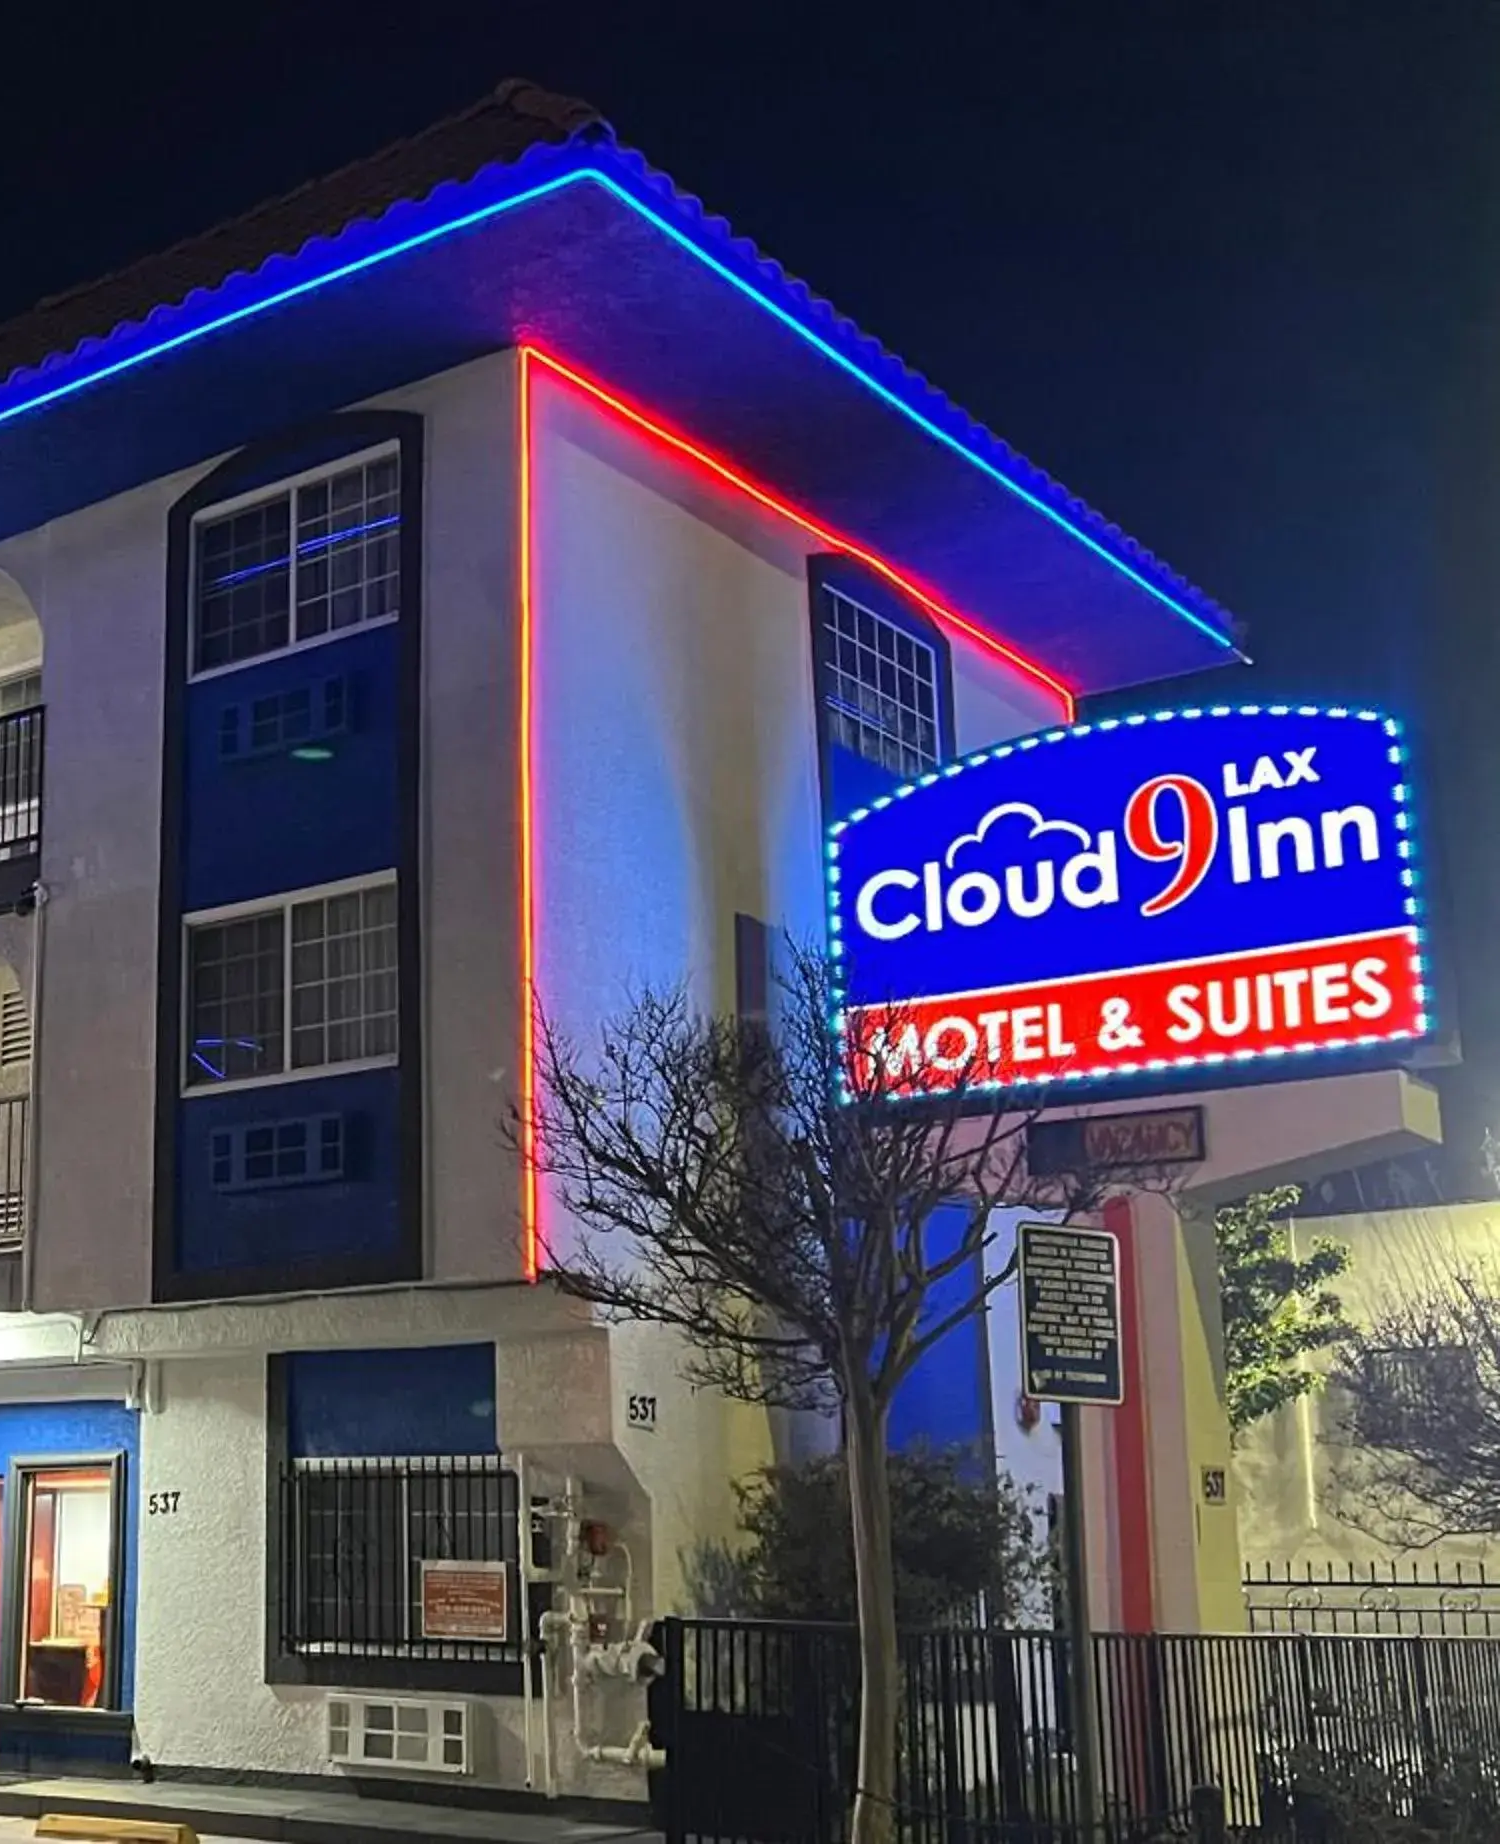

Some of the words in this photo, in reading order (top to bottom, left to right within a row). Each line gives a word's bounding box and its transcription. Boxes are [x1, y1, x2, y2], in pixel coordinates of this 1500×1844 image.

[1223, 746, 1320, 798] LAX
[856, 829, 1120, 941] Cloud
[1124, 773, 1218, 917] 9
[1227, 805, 1380, 884] Inn
[867, 1003, 1076, 1079] MOTEL
[1097, 997, 1145, 1051] &
[1166, 957, 1392, 1043] SUITES
[629, 1395, 656, 1423] 537
[149, 1491, 181, 1516] 537
